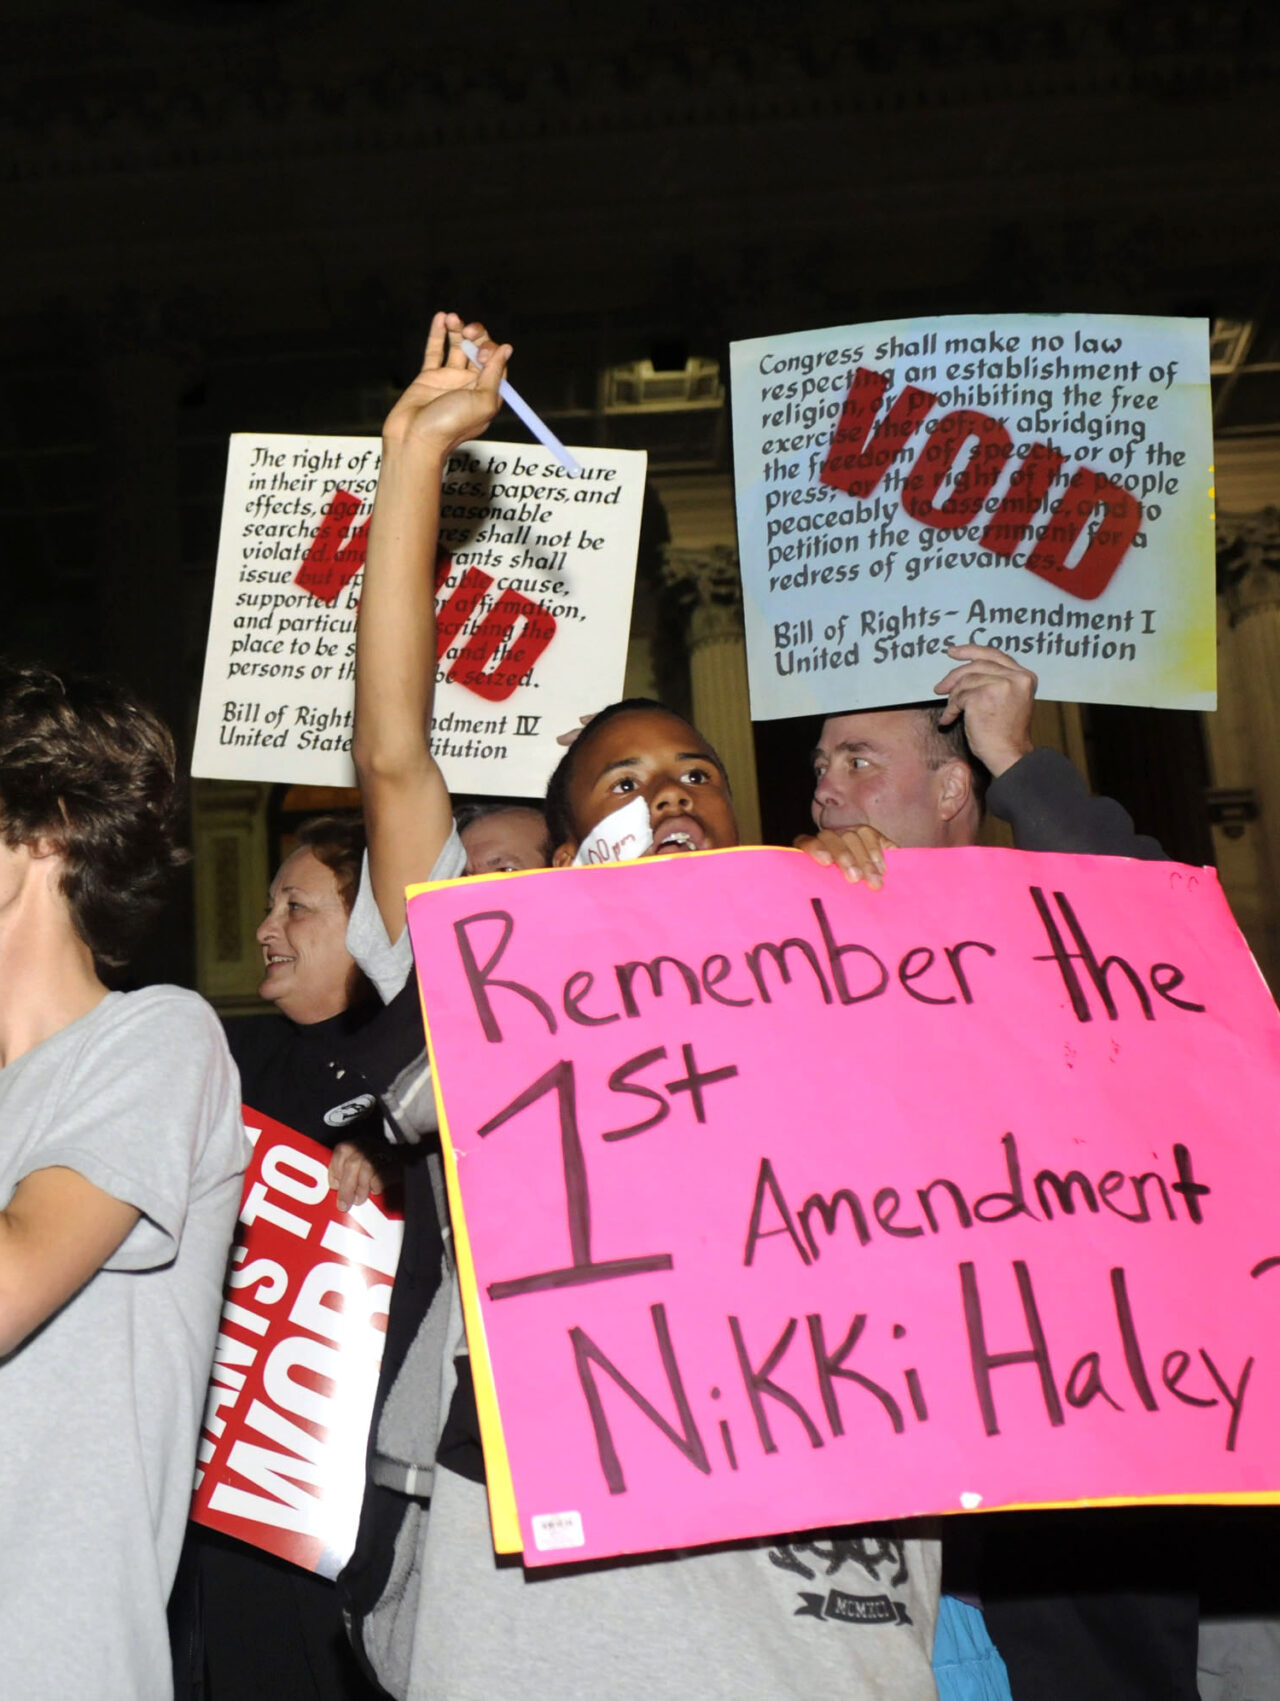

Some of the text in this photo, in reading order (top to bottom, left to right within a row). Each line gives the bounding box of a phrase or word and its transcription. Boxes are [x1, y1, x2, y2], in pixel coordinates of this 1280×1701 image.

[759, 331, 1122, 376] Congress shall make no law
[761, 355, 1179, 402] respecting an establishment of
[761, 383, 1159, 429] religion, or prohibiting the free
[761, 424, 862, 455] exercise
[982, 415, 1010, 433] or
[1016, 409, 1146, 444] abridging
[250, 447, 286, 468] The
[292, 449, 343, 473] right
[348, 450, 373, 475] of
[446, 452, 480, 475] ple
[486, 456, 507, 474] to
[512, 456, 539, 477] be
[763, 457, 800, 482] the
[808, 445, 915, 482] freedom
[926, 438, 956, 467] of
[1109, 440, 1140, 469] of
[1146, 441, 1186, 467] the
[847, 480, 875, 497] or
[883, 468, 924, 492] the
[933, 463, 1002, 494] right
[1009, 463, 1038, 489] of
[1048, 466, 1083, 489] the
[1094, 470, 1179, 499] people
[248, 472, 266, 490] in
[271, 472, 318, 491] their
[321, 478, 377, 497] perso
[490, 483, 570, 502] papers,
[574, 486, 622, 504] and
[818, 366, 1143, 601] VOID
[245, 494, 316, 519] effects,
[441, 503, 553, 523] easonable
[767, 498, 899, 544] peaceably
[909, 498, 933, 518] to
[1077, 498, 1129, 518] and
[1138, 501, 1162, 521] to
[242, 520, 331, 538] searches
[337, 524, 369, 539] an
[476, 524, 532, 545] shall
[535, 530, 572, 547] not
[577, 530, 605, 550] be
[768, 520, 1148, 571] petition the government for a
[239, 564, 292, 584] issue
[497, 577, 570, 596] cause,
[448, 548, 503, 568] rants
[509, 549, 567, 571] shall
[770, 547, 1064, 592] redress of grievances.
[233, 611, 273, 630] and
[521, 620, 555, 640] the
[235, 590, 340, 611] supported
[455, 593, 587, 621] affirmation,
[774, 619, 813, 649] Bill
[824, 615, 849, 645] of
[966, 599, 1134, 632] Amendment
[1140, 609, 1157, 634] I
[230, 634, 284, 656] place
[290, 638, 311, 655] to
[315, 637, 338, 656] be
[446, 643, 486, 661] and
[492, 644, 525, 662] the
[774, 627, 1136, 676] United States Constitution
[227, 661, 306, 679] persons
[311, 665, 333, 679] or
[463, 666, 540, 688] seized.
[220, 725, 289, 748] United
[297, 730, 353, 752] State
[222, 700, 261, 723] Bill
[264, 705, 289, 729] of
[294, 705, 355, 732] Right
[513, 715, 543, 736] IV
[454, 885, 1206, 1044] Remember the
[238, 1142, 334, 1241] TO
[476, 1043, 740, 1302] 1st
[743, 1132, 1213, 1268] Amendment
[207, 1194, 405, 1548] WORK
[958, 1258, 1256, 1453] Haley
